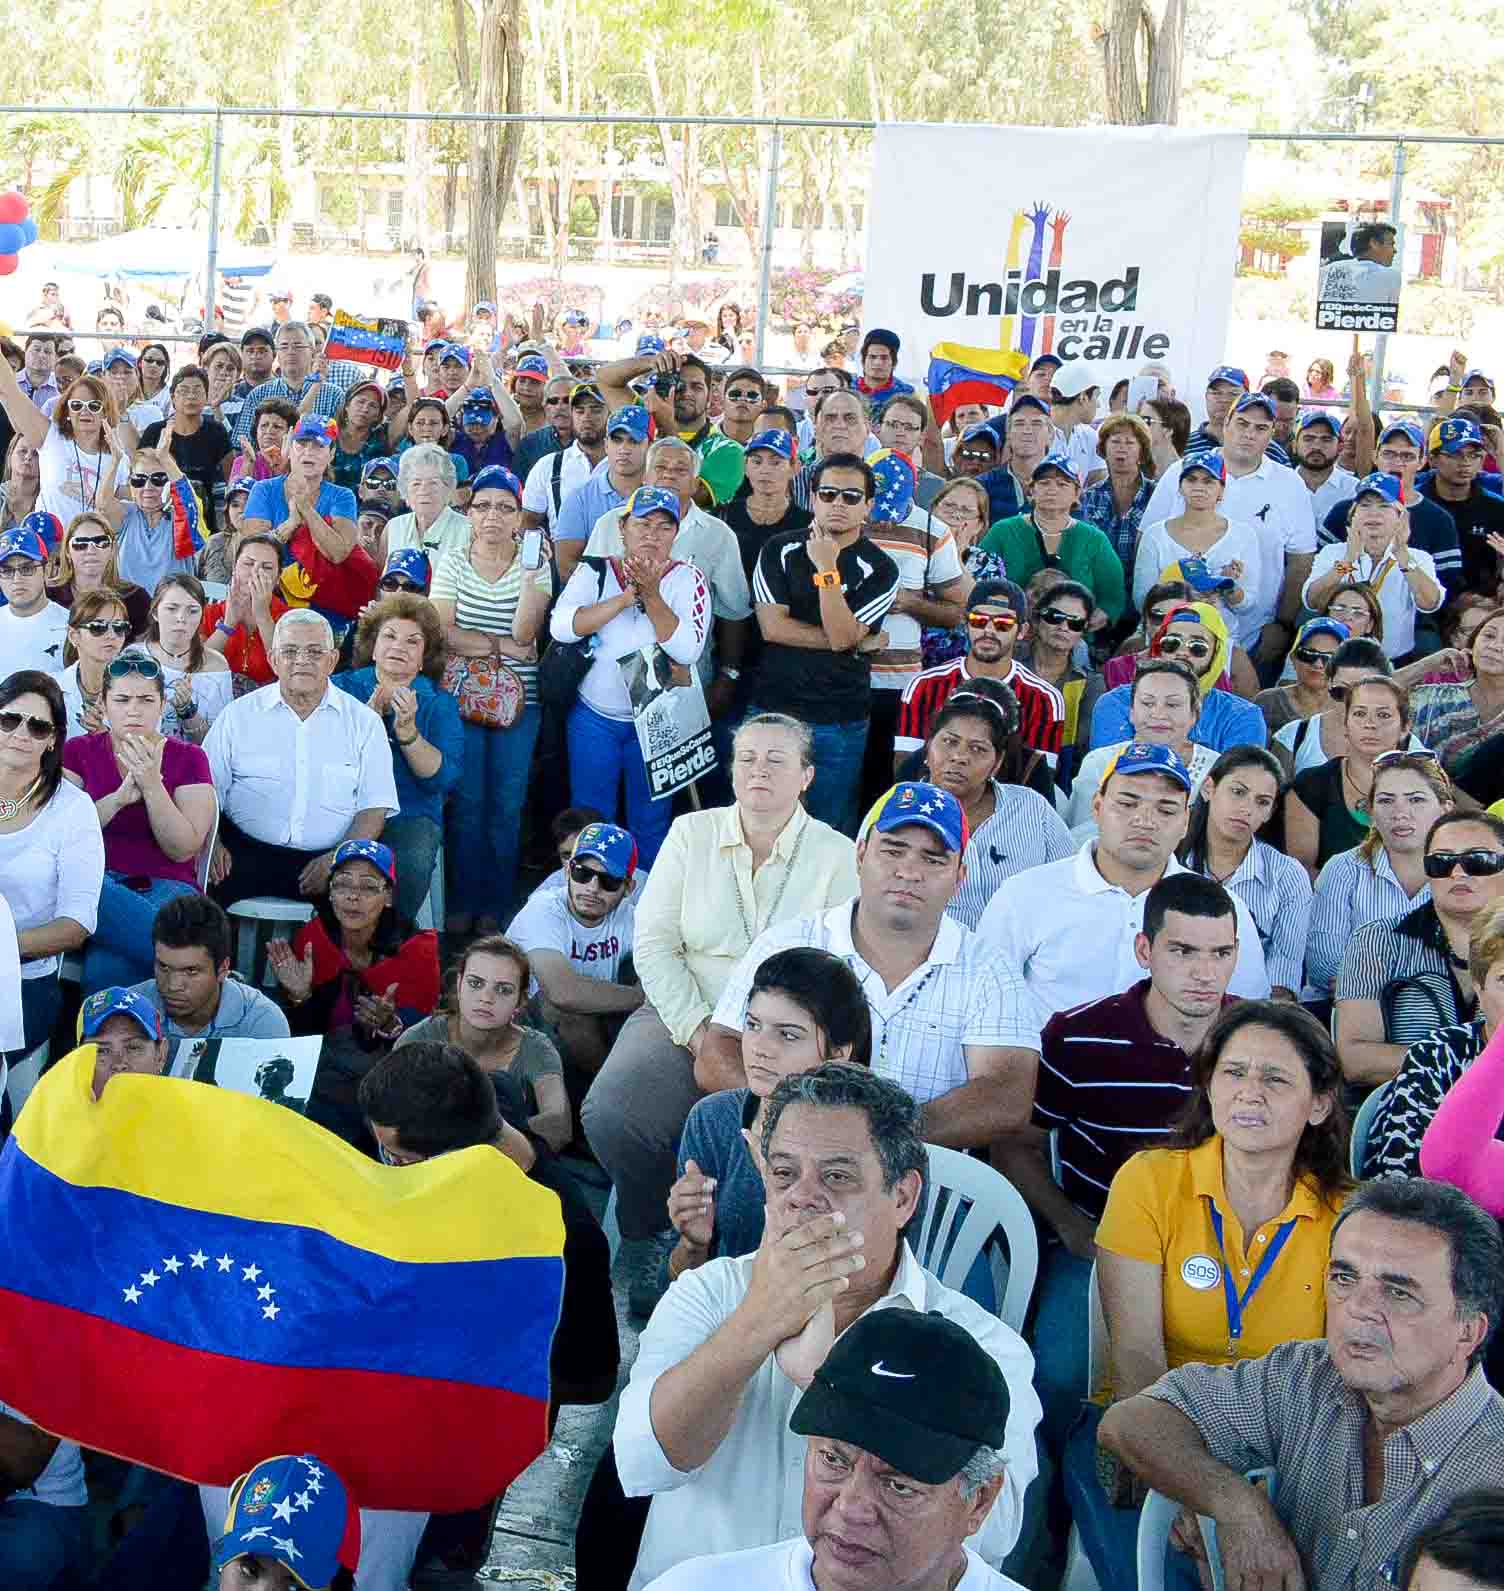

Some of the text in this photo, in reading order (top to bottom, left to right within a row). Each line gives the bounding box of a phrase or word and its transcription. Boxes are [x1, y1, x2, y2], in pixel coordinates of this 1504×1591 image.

[920, 266, 1140, 317] Unidad
[1059, 315, 1113, 333] en la
[1318, 310, 1394, 329] Pierde
[1057, 326, 1170, 361] calle
[651, 731, 712, 770] #ElQueSeCansa
[651, 745, 716, 792] Pierde
[1186, 1263, 1216, 1280] SOS
